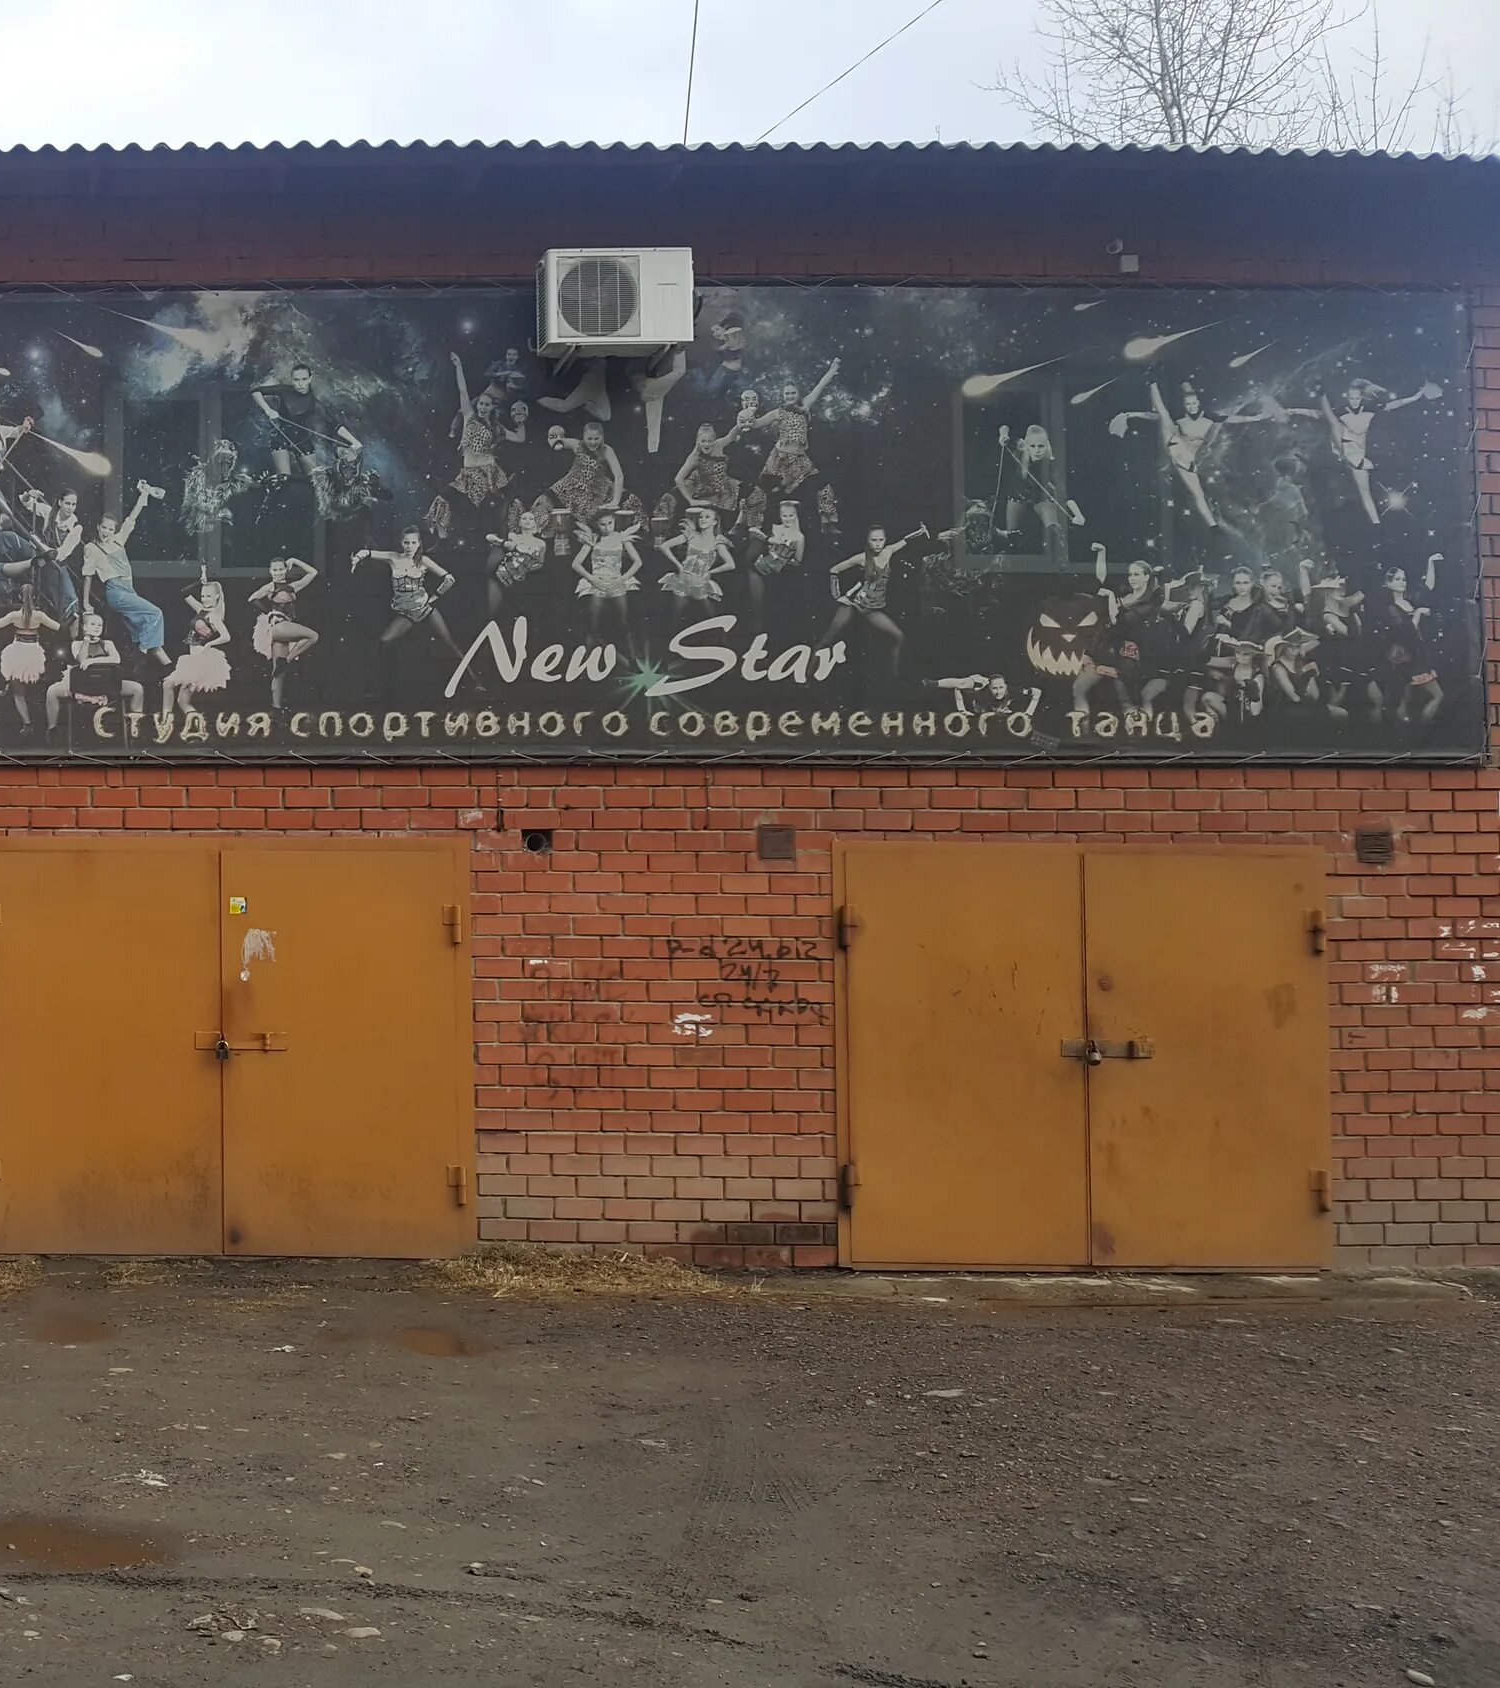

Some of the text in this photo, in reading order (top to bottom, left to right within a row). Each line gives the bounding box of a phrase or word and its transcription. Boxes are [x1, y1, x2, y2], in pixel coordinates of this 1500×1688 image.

[444, 614, 848, 699] New Star
[92, 706, 1217, 743] Студия спортивного современного танца
